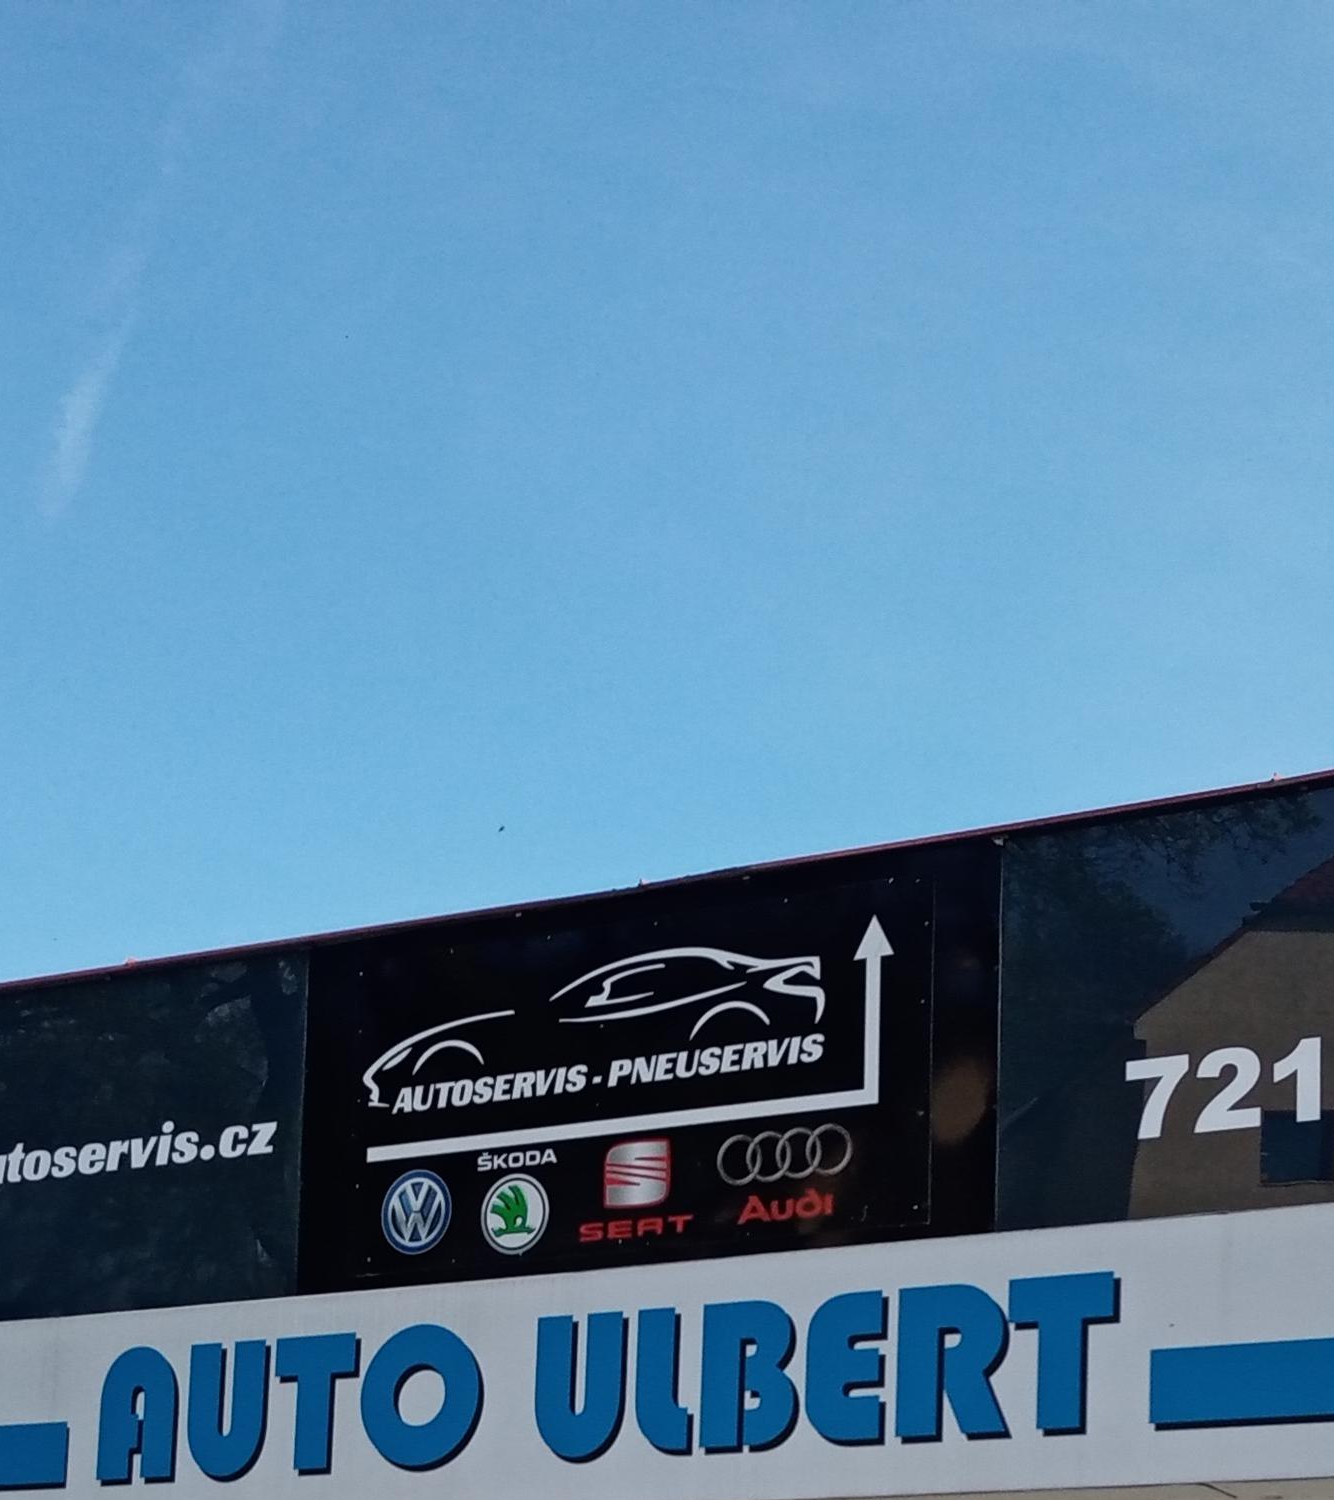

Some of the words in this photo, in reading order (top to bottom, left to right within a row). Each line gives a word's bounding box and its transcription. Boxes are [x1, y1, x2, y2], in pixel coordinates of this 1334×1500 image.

[392, 1064, 587, 1114] AUTOSERVIS
[607, 1034, 825, 1088] PNEUSERVIS
[1125, 1037, 1321, 1139] 721
[477, 1148, 557, 1172] ŠKODA
[579, 1215, 693, 1242] SEAT
[737, 1188, 833, 1225] Audi
[96, 1323, 484, 1484] AUTO
[535, 1271, 1121, 1463] ULBERT
